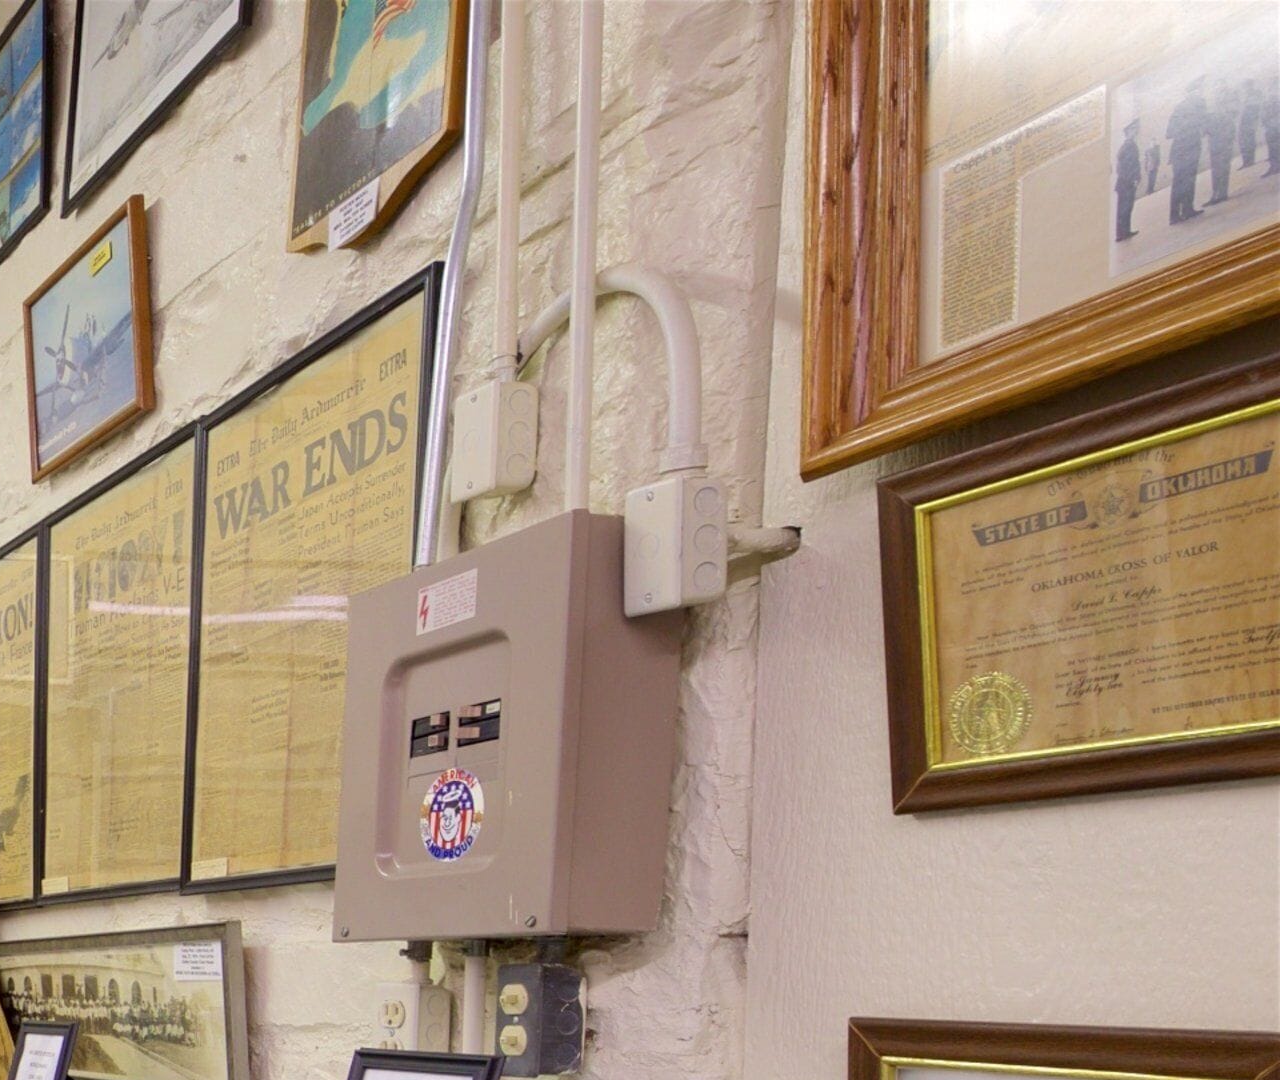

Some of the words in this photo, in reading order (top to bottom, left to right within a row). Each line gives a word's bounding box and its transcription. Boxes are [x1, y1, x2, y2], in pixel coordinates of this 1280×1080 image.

[217, 451, 240, 476] EXTRA
[379, 349, 407, 382] EXTRA
[214, 460, 292, 539] WAR
[303, 391, 408, 497] ENDS
[383, 506, 405, 523] Says
[984, 514, 1042, 543] STATE
[1046, 506, 1071, 526] OF
[1146, 455, 1257, 499] OKLAHOMA
[163, 566, 185, 594] V-E
[1031, 567, 1103, 592] OKLAHOMA
[1107, 557, 1147, 575] CROSS
[1152, 551, 1171, 565] OF
[1176, 540, 1218, 559] VALOR
[443, 835, 474, 859] PROUD
